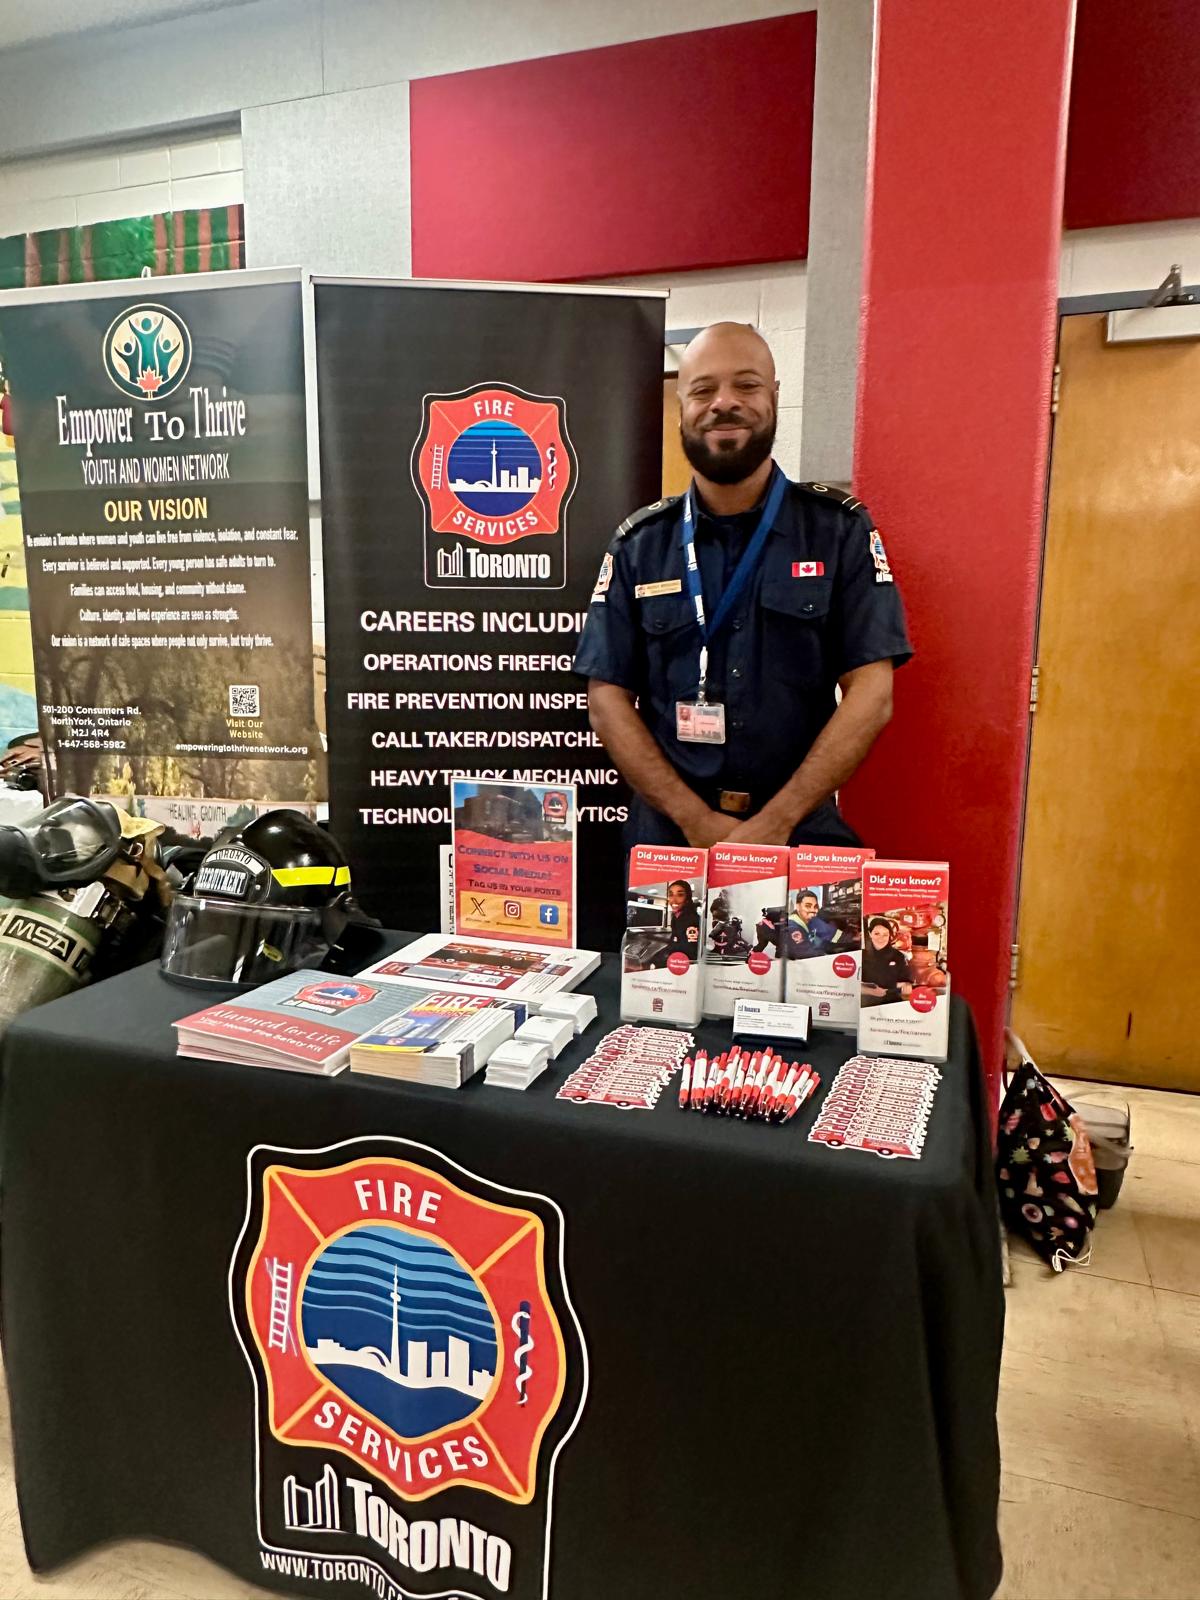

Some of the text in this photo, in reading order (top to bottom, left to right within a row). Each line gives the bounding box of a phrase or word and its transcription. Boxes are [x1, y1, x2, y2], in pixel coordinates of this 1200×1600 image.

[474, 399, 515, 418] FIRE
[56, 386, 246, 457] Empower To Thrive
[81, 453, 230, 485] YOUTH AND WOMEN NETWORK
[104, 497, 208, 523] OUR VISION
[453, 510, 539, 537] SERVICES
[117, 531, 128, 545] and
[129, 531, 144, 547] youth
[145, 534, 156, 545] can
[244, 526, 255, 541] and
[256, 528, 282, 541] constant
[283, 526, 299, 541] fear.
[42, 558, 57, 574] Every
[110, 557, 122, 570] and
[152, 557, 168, 572] Every
[168, 559, 185, 572] young
[205, 555, 215, 568] has
[254, 556, 267, 567] turn
[268, 555, 276, 567] to.
[466, 548, 550, 579] TORONTO
[70, 583, 94, 596] Families
[94, 586, 105, 596] can
[106, 586, 125, 596] access
[126, 608, 136, 621] and
[181, 611, 190, 620] are
[191, 611, 204, 621] seen
[204, 610, 212, 620] as
[360, 611, 475, 632] CAREERS
[51, 634, 60, 647] Our
[111, 634, 118, 646] of
[230, 633, 240, 646] but
[363, 654, 492, 671] OPERATIONS
[42, 704, 142, 715] 501-200 Consumers Rd.
[347, 693, 588, 710] FIRE PREVENTION INSPE
[52, 717, 132, 727] North York, Ontario
[226, 719, 264, 728] Visit Our
[91, 729, 110, 737] 4R4
[229, 730, 264, 739] Website
[371, 732, 603, 748] CALL TAKER/DISPATCHE
[58, 740, 126, 749] 1-647-568-5982
[176, 743, 308, 755] empoweringtothrivenetwork.org
[370, 770, 438, 786] HEAVY
[513, 769, 619, 785] MECHANIC
[359, 806, 629, 825] TECHNOL YTICS
[552, 855, 569, 863] ON
[638, 851, 699, 864] Did you know?
[716, 852, 778, 864] Did you know?
[796, 852, 812, 860] Did
[832, 853, 862, 862] know?
[474, 863, 510, 877] SOCIAL
[468, 879, 486, 889] TAG
[870, 875, 942, 886] Did you know?
[8, 918, 70, 958] MSA
[420, 995, 490, 1010] FIRE
[207, 1010, 341, 1046] Alarmed for Life
[272, 1034, 307, 1047] Safety
[306, 1043, 323, 1053] Kit
[354, 1178, 442, 1225] FIRE
[313, 1400, 490, 1483] SERVICES
[347, 1477, 513, 1593] TORONTO
[260, 1551, 404, 1600] WWW.TORONTO.C
